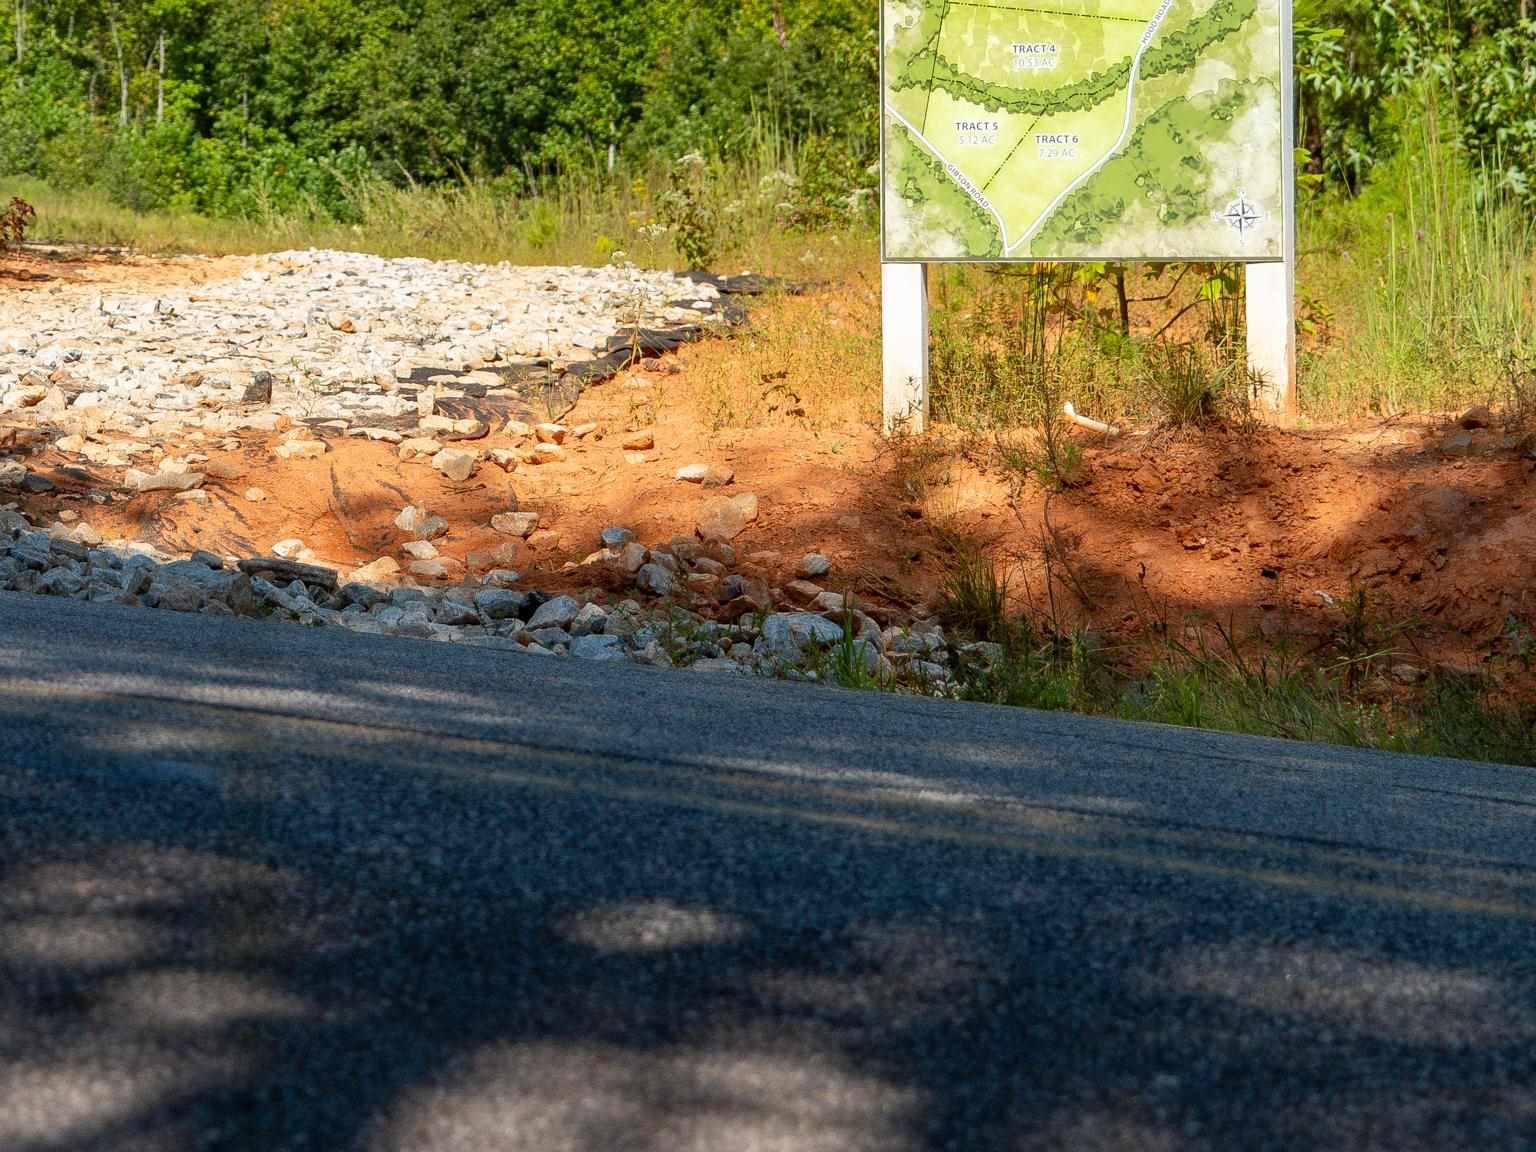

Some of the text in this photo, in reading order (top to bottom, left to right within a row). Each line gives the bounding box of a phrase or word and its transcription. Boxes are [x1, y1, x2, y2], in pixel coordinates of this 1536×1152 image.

[1013, 44, 1056, 54] TRACT 4
[955, 121, 999, 131] TRACT 5
[1035, 134, 1079, 144] TRACT 6
[970, 188, 990, 208] ROAD
